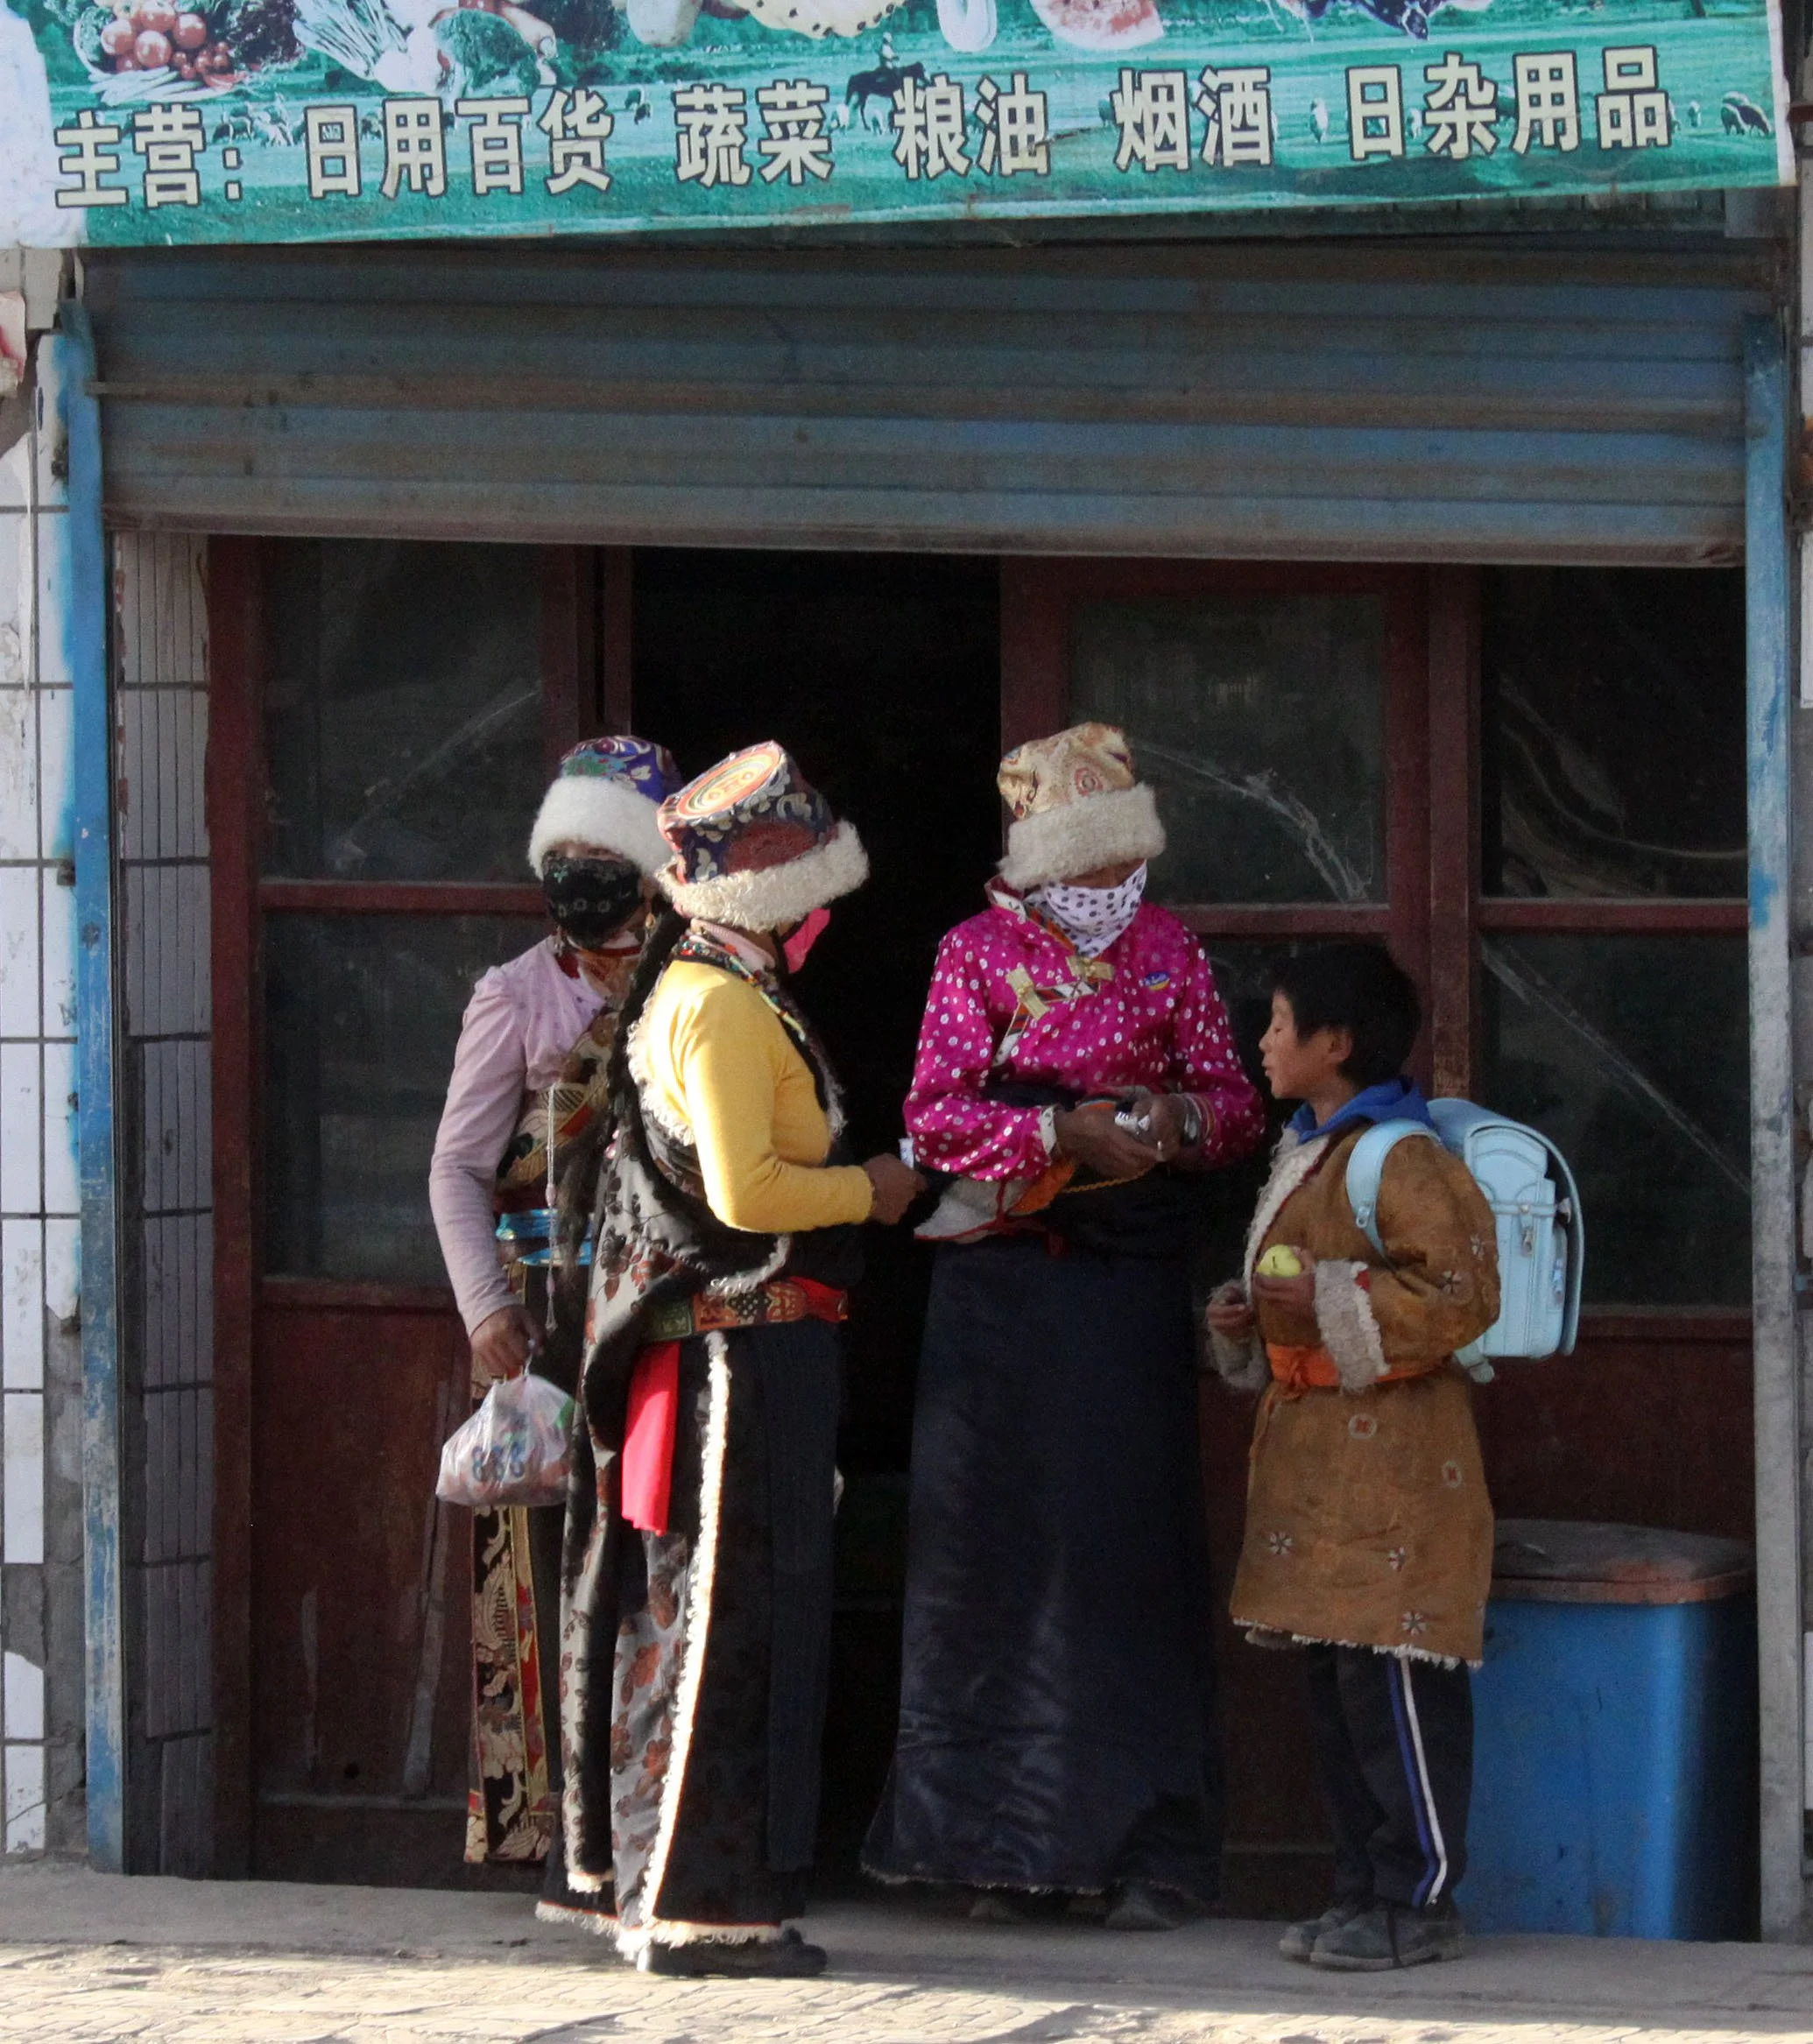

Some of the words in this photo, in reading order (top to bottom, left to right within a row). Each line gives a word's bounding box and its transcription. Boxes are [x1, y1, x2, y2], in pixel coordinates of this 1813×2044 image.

[303, 88, 612, 199] 日用百货
[674, 80, 833, 188] 蔬菜
[892, 72, 1052, 180] 粮油
[1113, 66, 1274, 171] 烟酒
[1344, 46, 1670, 160] 日杂用品
